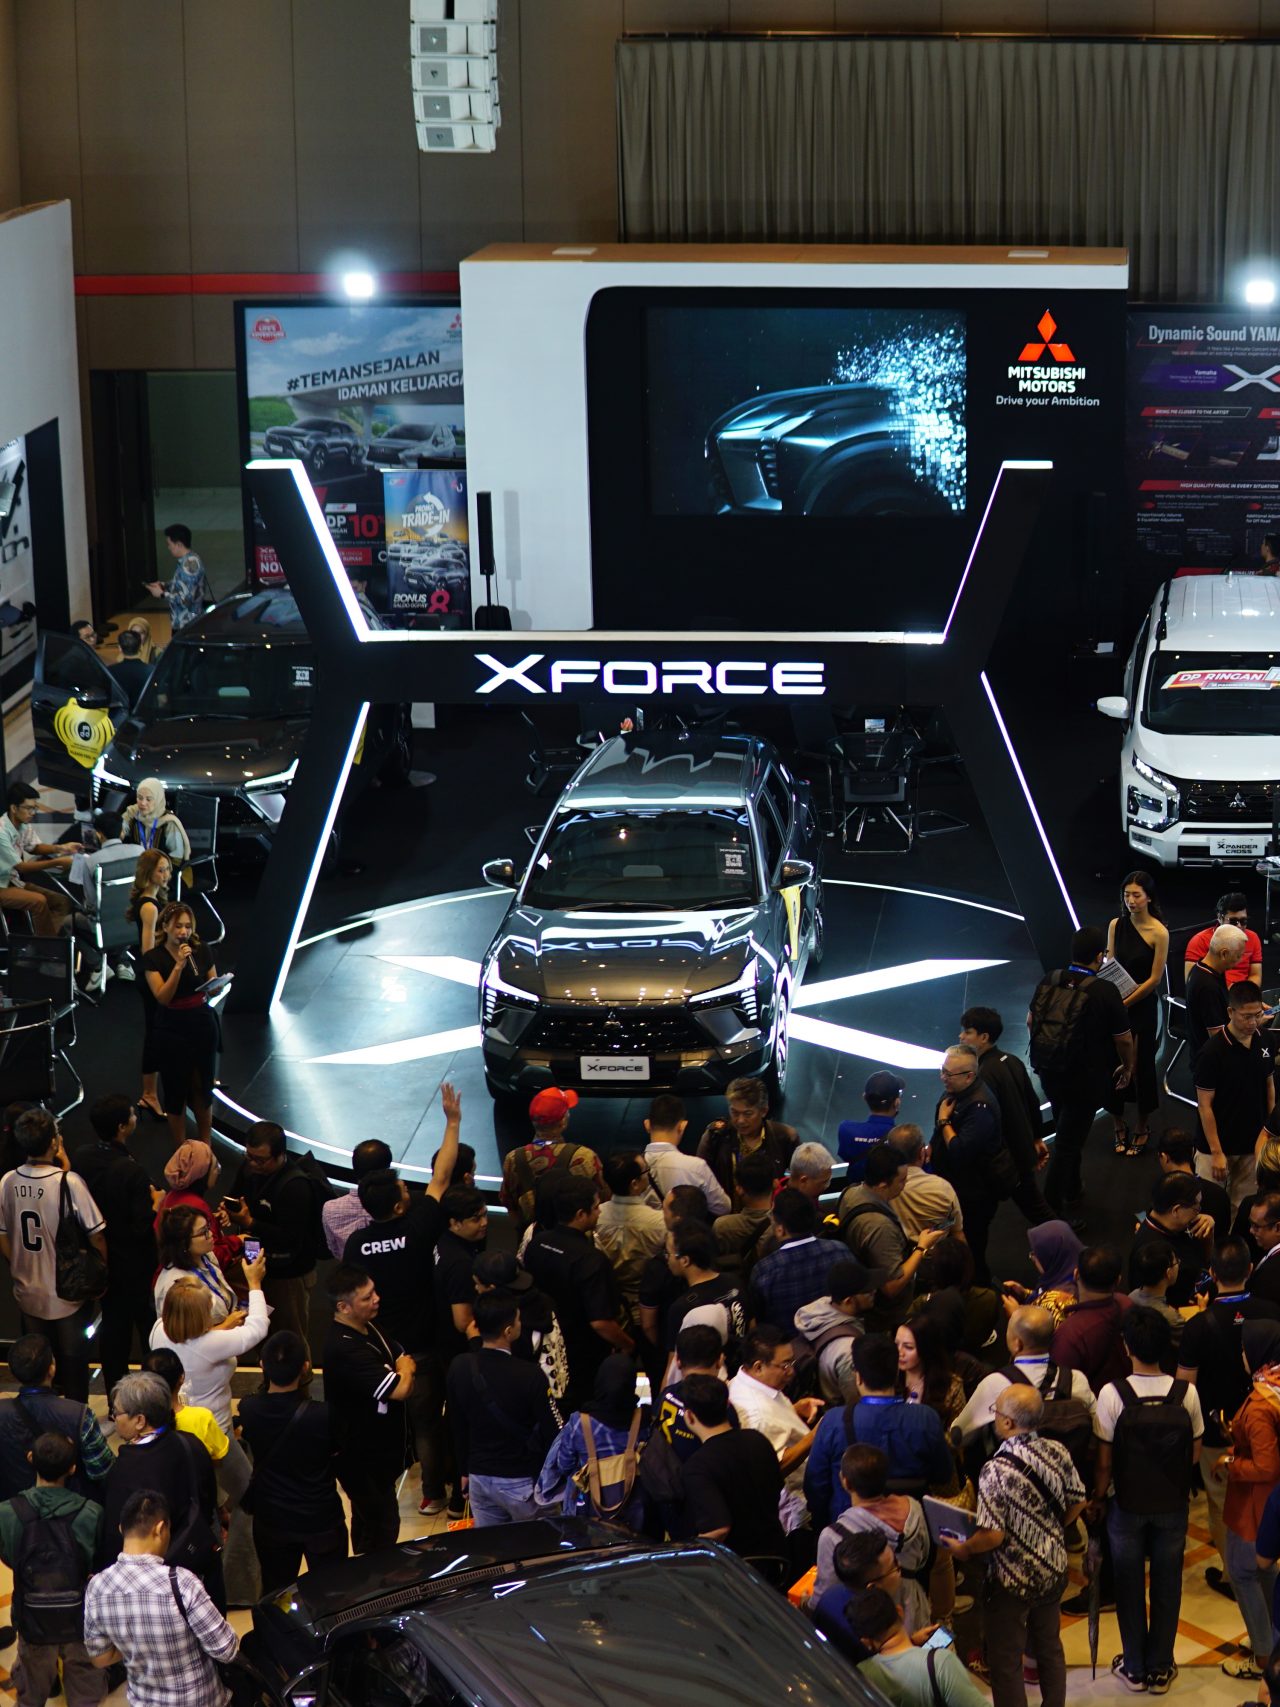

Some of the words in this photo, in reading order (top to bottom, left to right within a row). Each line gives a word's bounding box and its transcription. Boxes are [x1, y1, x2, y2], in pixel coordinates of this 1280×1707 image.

[1148, 325, 1203, 344] Dynamic
[1206, 325, 1246, 341] Sound
[287, 350, 440, 391] #TEMANSEJALAN
[1008, 366, 1086, 380] MITSUBISHI
[338, 382, 388, 401] IDAMAN
[1018, 380, 1076, 393] MOTORS
[996, 395, 1024, 405] Drive
[1025, 398, 1049, 407] your
[1051, 396, 1100, 406] Ambition
[327, 515, 346, 527] DP
[401, 508, 450, 528] TRADE-IN
[393, 593, 427, 603] BONUS
[474, 653, 826, 695] XFORCE
[1179, 673, 1201, 682] DP
[1205, 672, 1264, 681] RINGAN
[587, 1064, 643, 1072] XFORCE
[14, 1185, 44, 1199] 101.9
[20, 1210, 43, 1252] C
[361, 1236, 406, 1256] CREW
